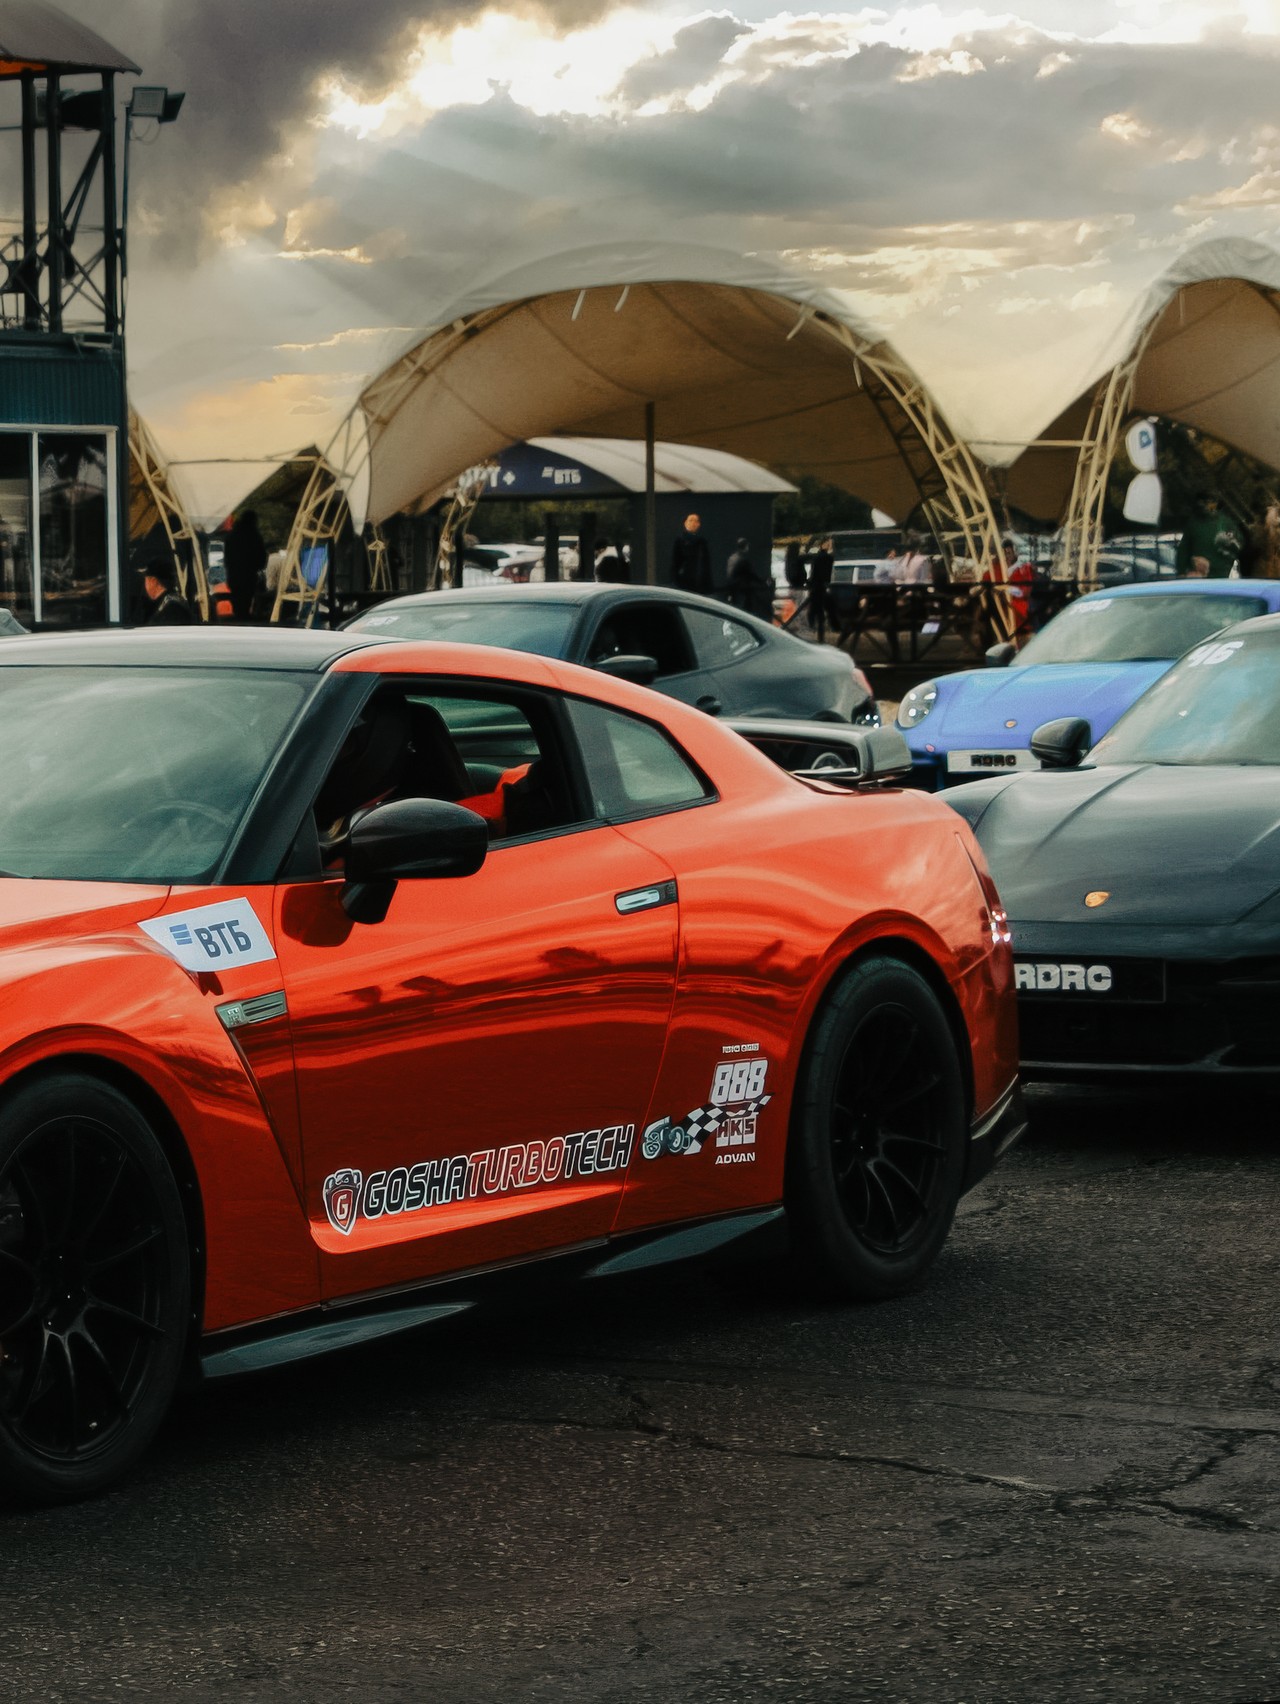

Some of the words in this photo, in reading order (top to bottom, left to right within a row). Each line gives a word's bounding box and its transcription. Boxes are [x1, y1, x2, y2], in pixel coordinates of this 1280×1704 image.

[194, 919, 252, 958] ВТБ
[1014, 963, 1112, 991] RDRC
[710, 1059, 768, 1107] 888
[361, 1123, 634, 1221] GOSHATURBOTECH
[715, 1152, 756, 1165] ADVAN
